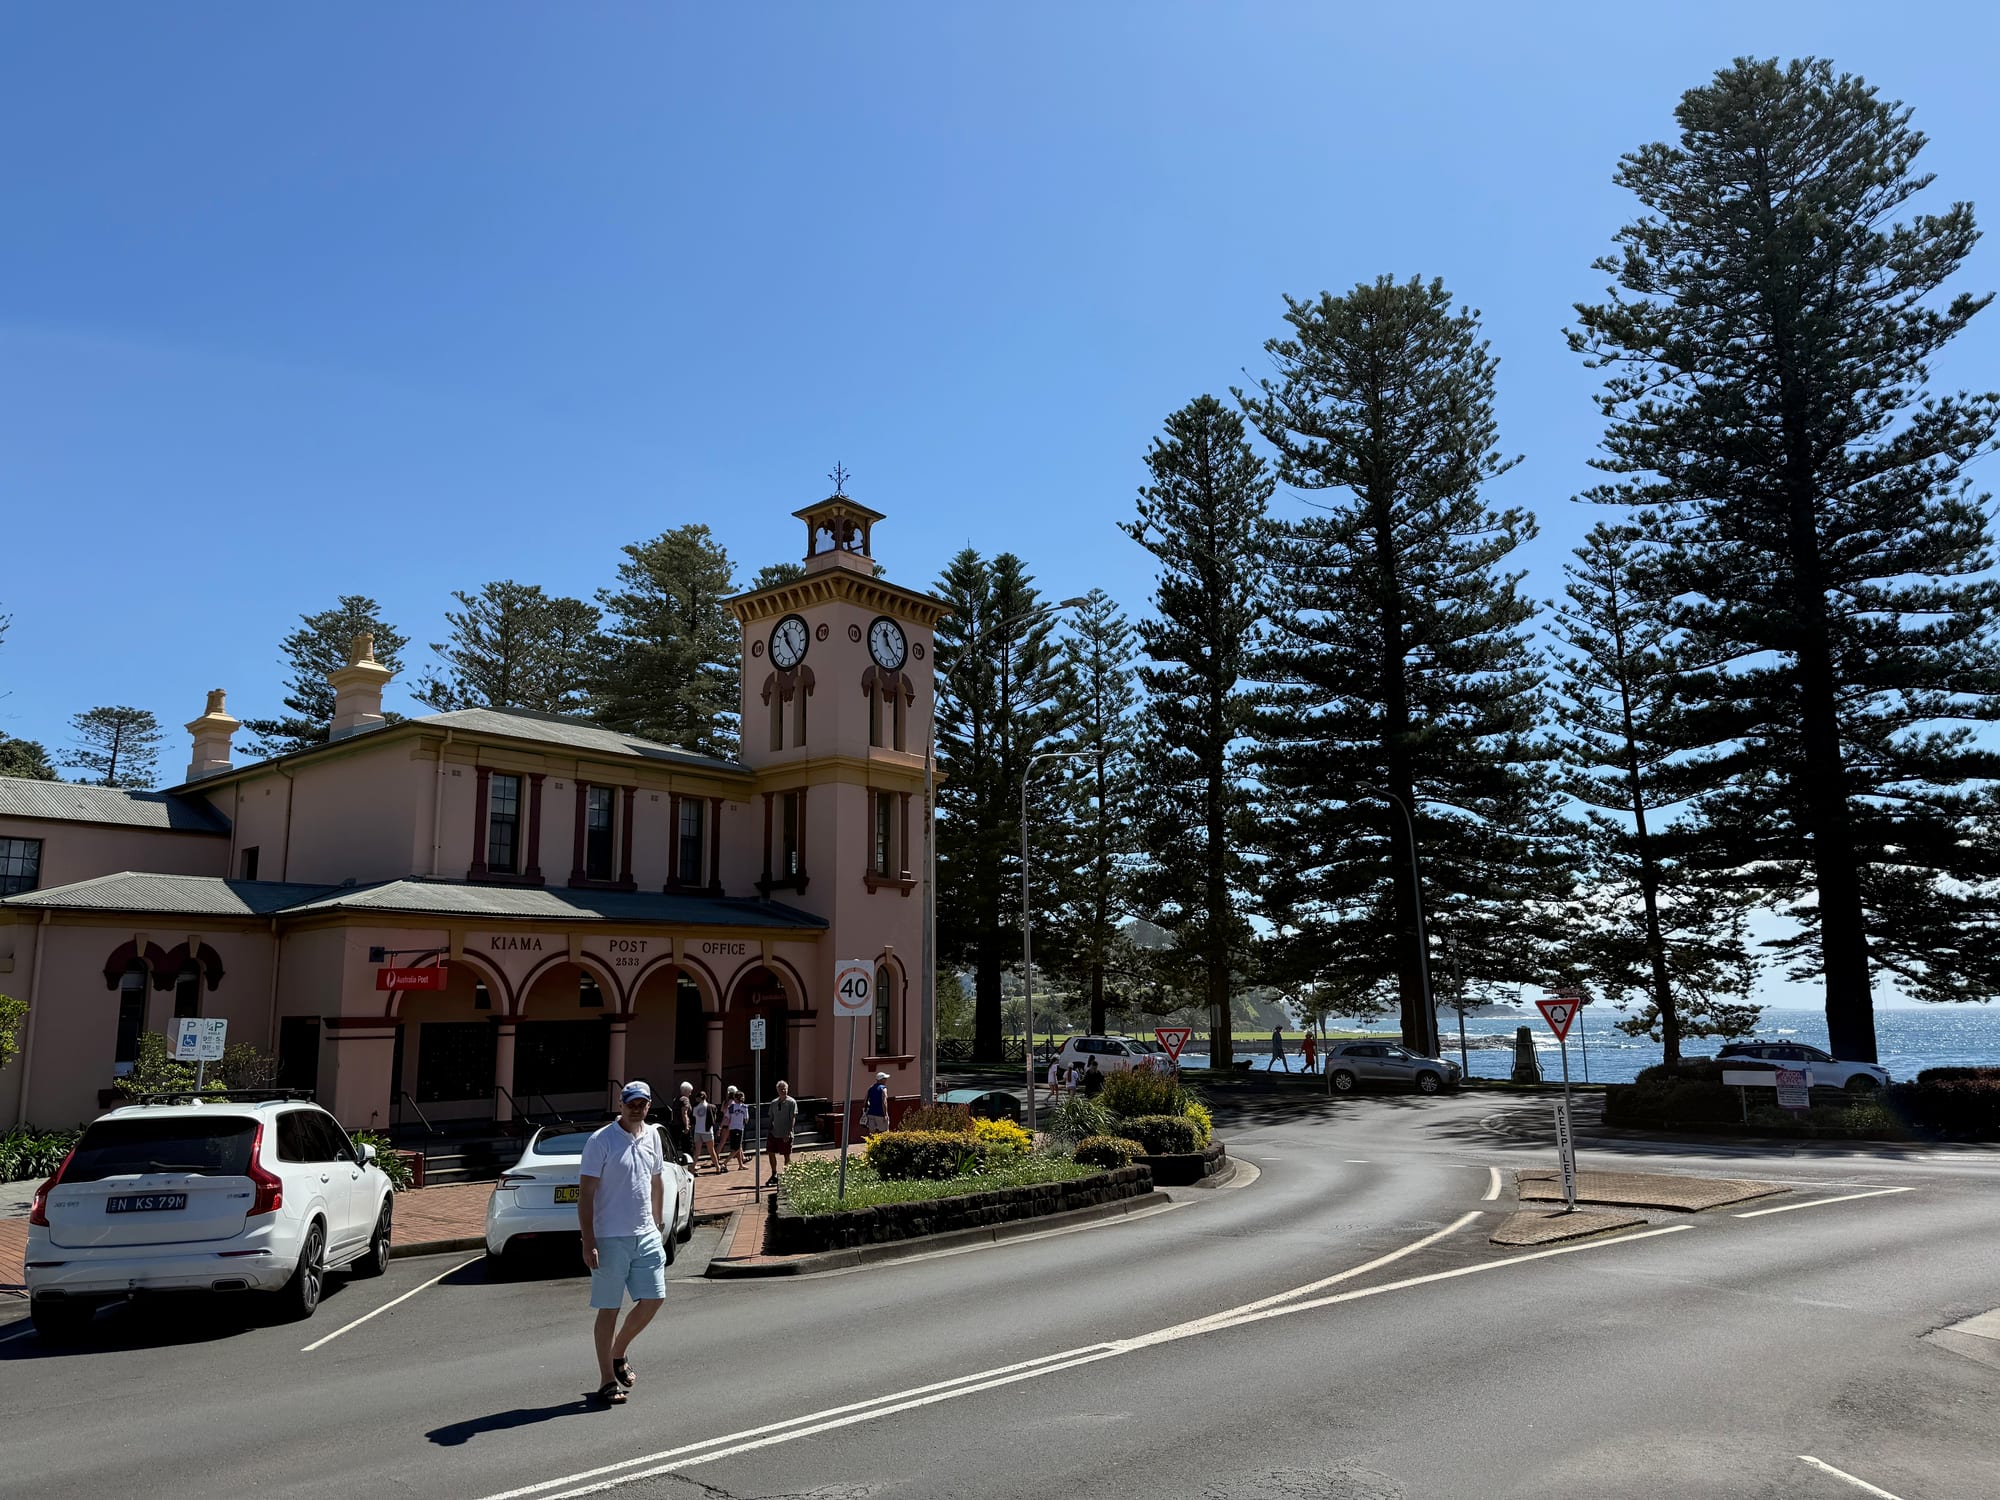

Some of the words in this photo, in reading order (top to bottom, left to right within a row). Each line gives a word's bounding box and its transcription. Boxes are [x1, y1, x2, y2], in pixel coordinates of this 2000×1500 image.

[490, 936, 543, 951] KIAMA
[609, 939, 648, 953] POST
[702, 942, 746, 956] OFFICE
[615, 957, 640, 967] 2533
[396, 975, 417, 984] Australia
[417, 975, 429, 984] Post
[840, 978, 868, 998] 40
[186, 1021, 197, 1031] P
[1557, 1105, 1568, 1148] KEEP
[1562, 1153, 1573, 1198] LEFT
[556, 1189, 566, 1199] DL
[135, 1197, 154, 1210] KS
